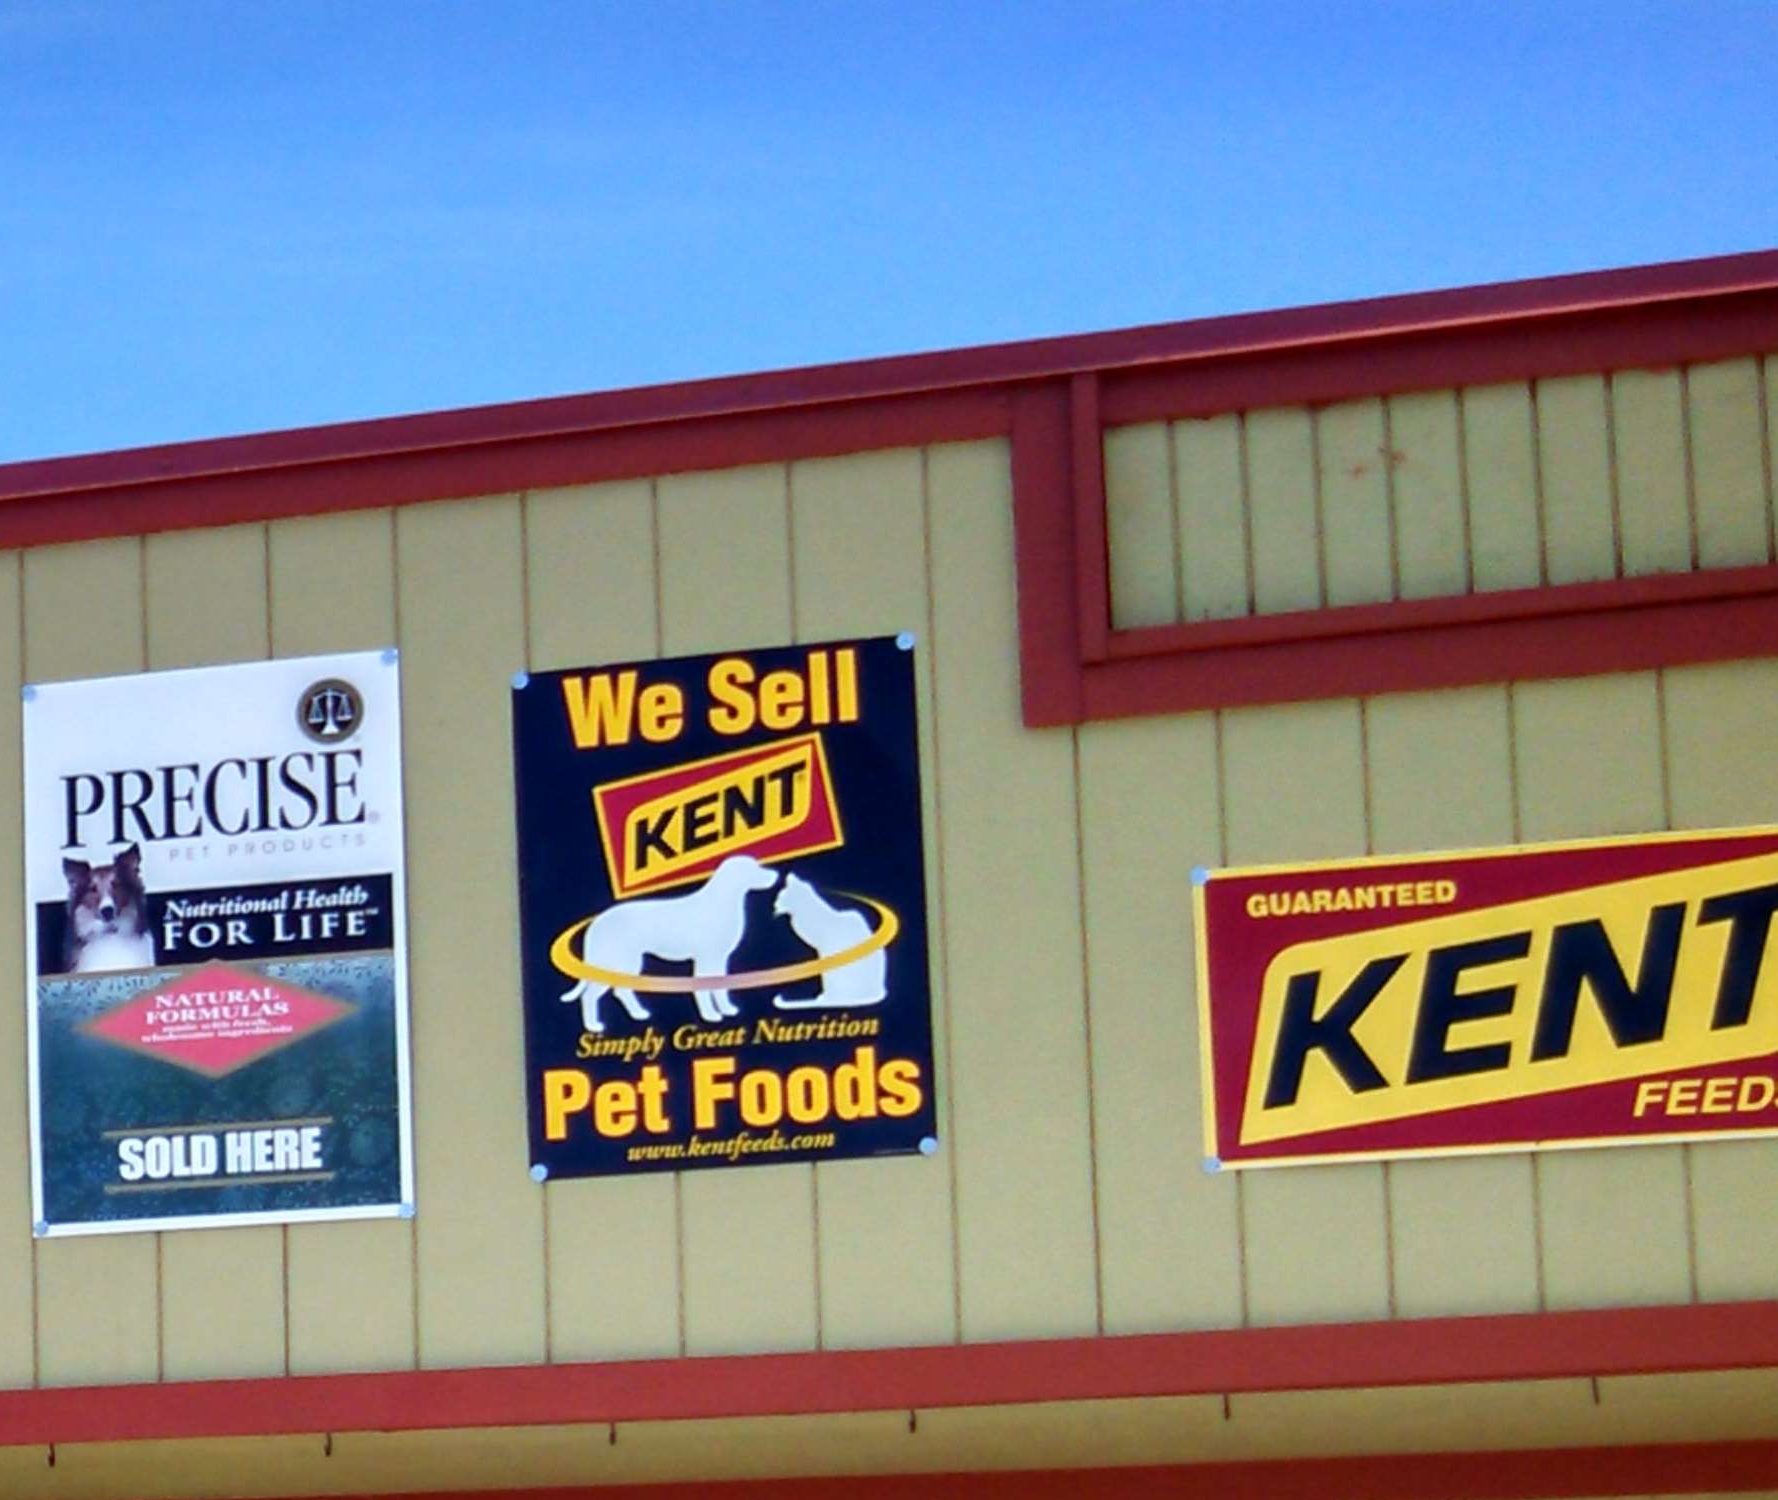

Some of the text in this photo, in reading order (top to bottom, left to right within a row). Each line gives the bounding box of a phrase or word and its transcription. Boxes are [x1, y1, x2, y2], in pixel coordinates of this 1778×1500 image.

[563, 648, 859, 749] We Sell
[59, 748, 366, 849] PRECISE
[634, 759, 808, 871] KENT
[169, 833, 366, 861] PET PRODUCTS
[165, 883, 369, 920] Nutritional Health
[1246, 879, 1458, 918] GUARANTEED
[162, 911, 367, 950] FOR LIFE
[145, 1001, 291, 1025] FORMULAS
[154, 987, 281, 1010] NATURAL
[1263, 884, 1778, 1110] KENT
[576, 1015, 881, 1063] Simply Great Nutrition
[543, 1045, 923, 1141] Pet Foods
[1633, 1074, 1778, 1118] FEED
[118, 1125, 323, 1181] SOLD HERE
[627, 1130, 835, 1163] www.kentfeeds.com
